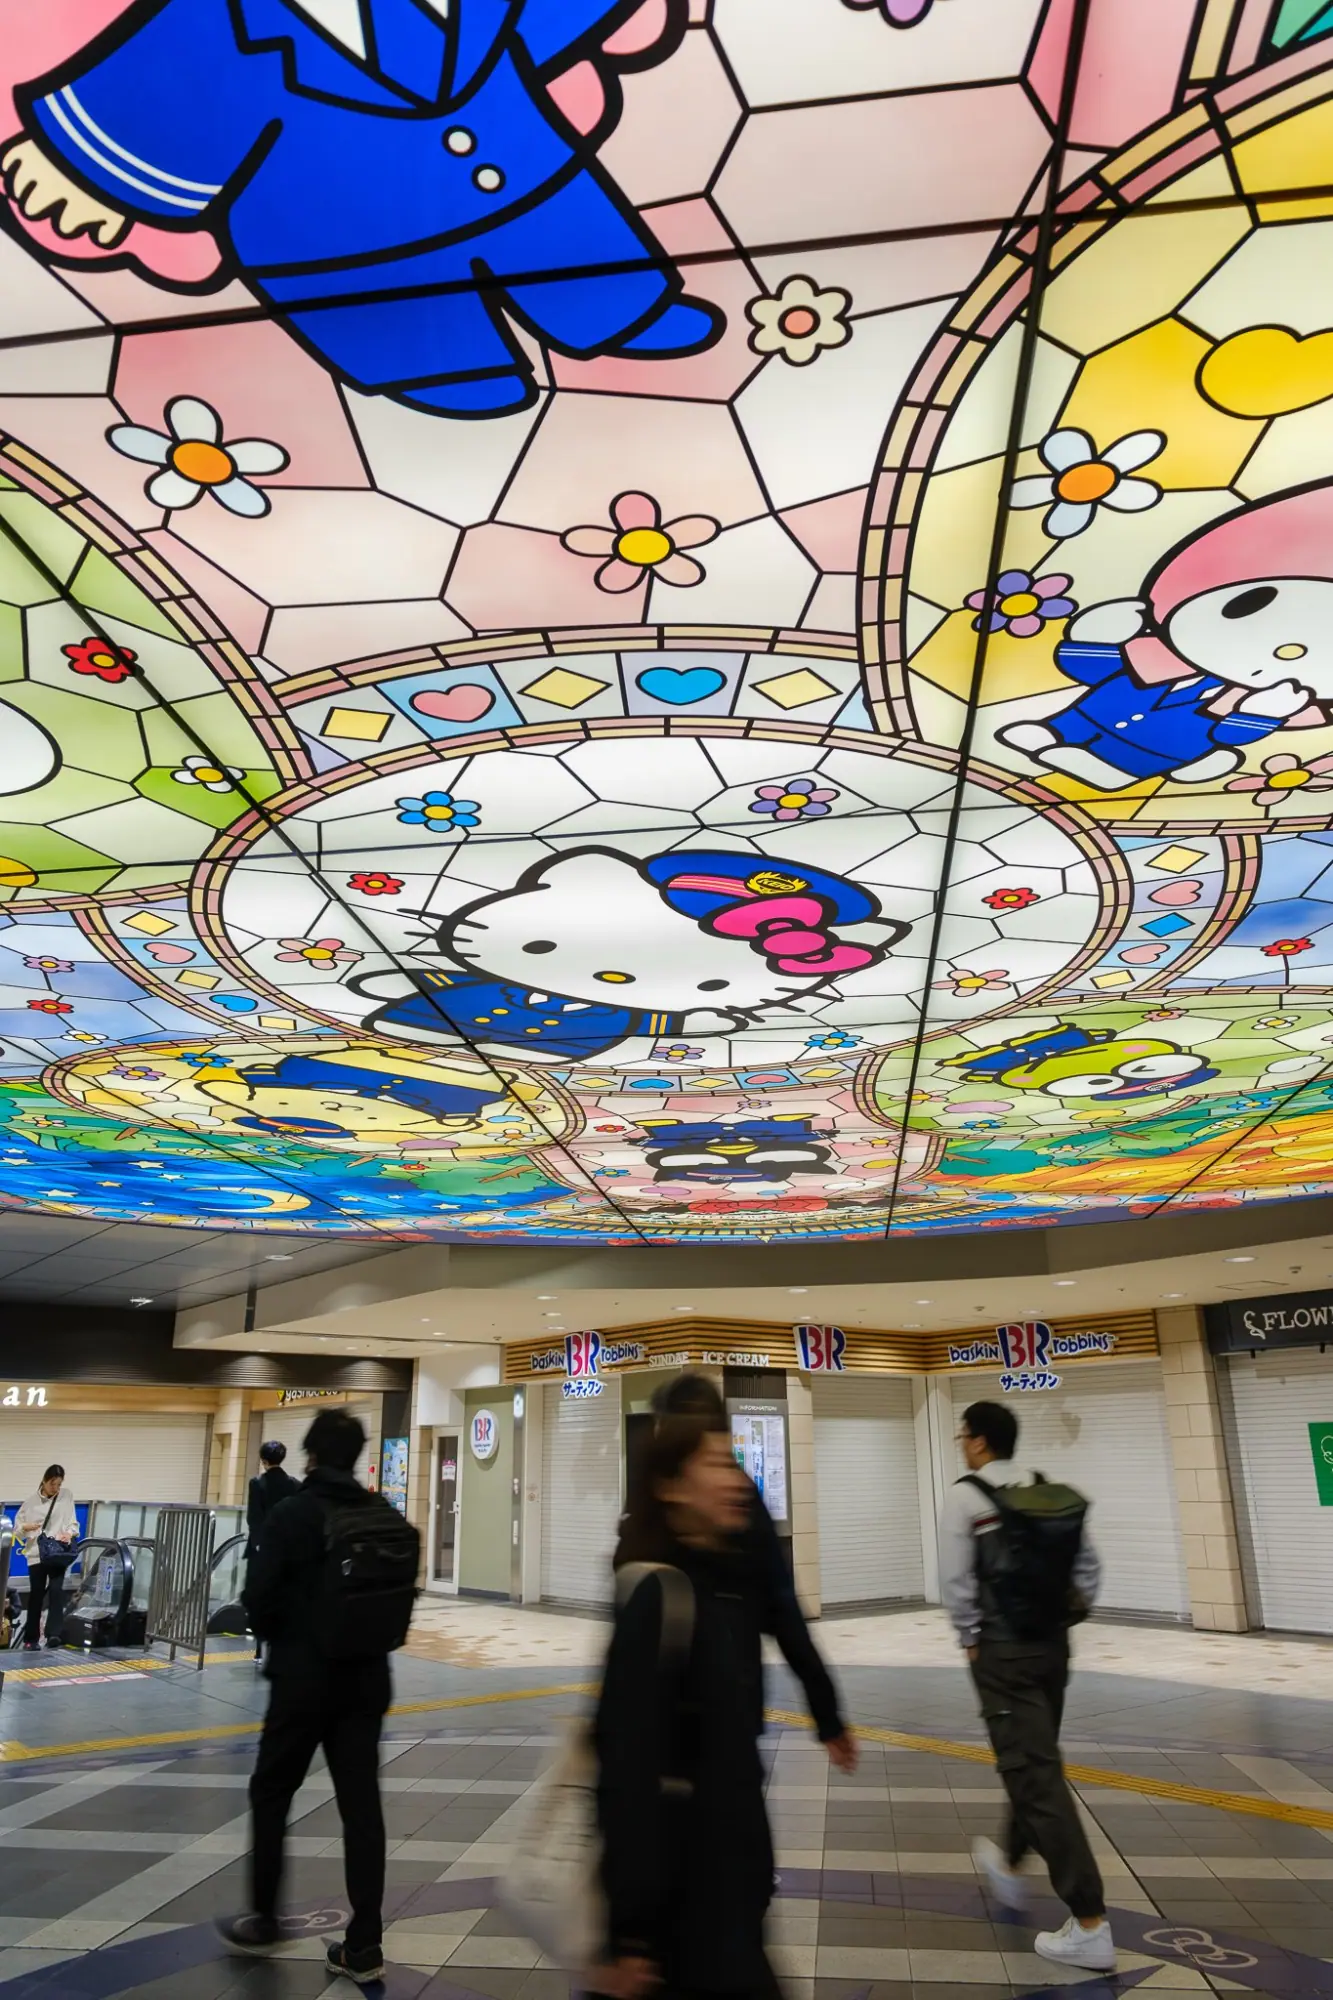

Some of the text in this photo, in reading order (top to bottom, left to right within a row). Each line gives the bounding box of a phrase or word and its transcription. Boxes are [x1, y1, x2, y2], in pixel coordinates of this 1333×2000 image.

[1262, 1306, 1333, 1331] FLOW
[532, 1331, 641, 1377] baskin BR robbins
[797, 1325, 846, 1371] BR
[950, 1322, 1109, 1368] baskin BR robbins
[648, 1352, 690, 1367] SUNDAE
[702, 1351, 770, 1367] ICE CREAM
[563, 1380, 603, 1398] サーティワン
[1001, 1373, 1059, 1391] サーティワン
[474, 1417, 492, 1442] BR
